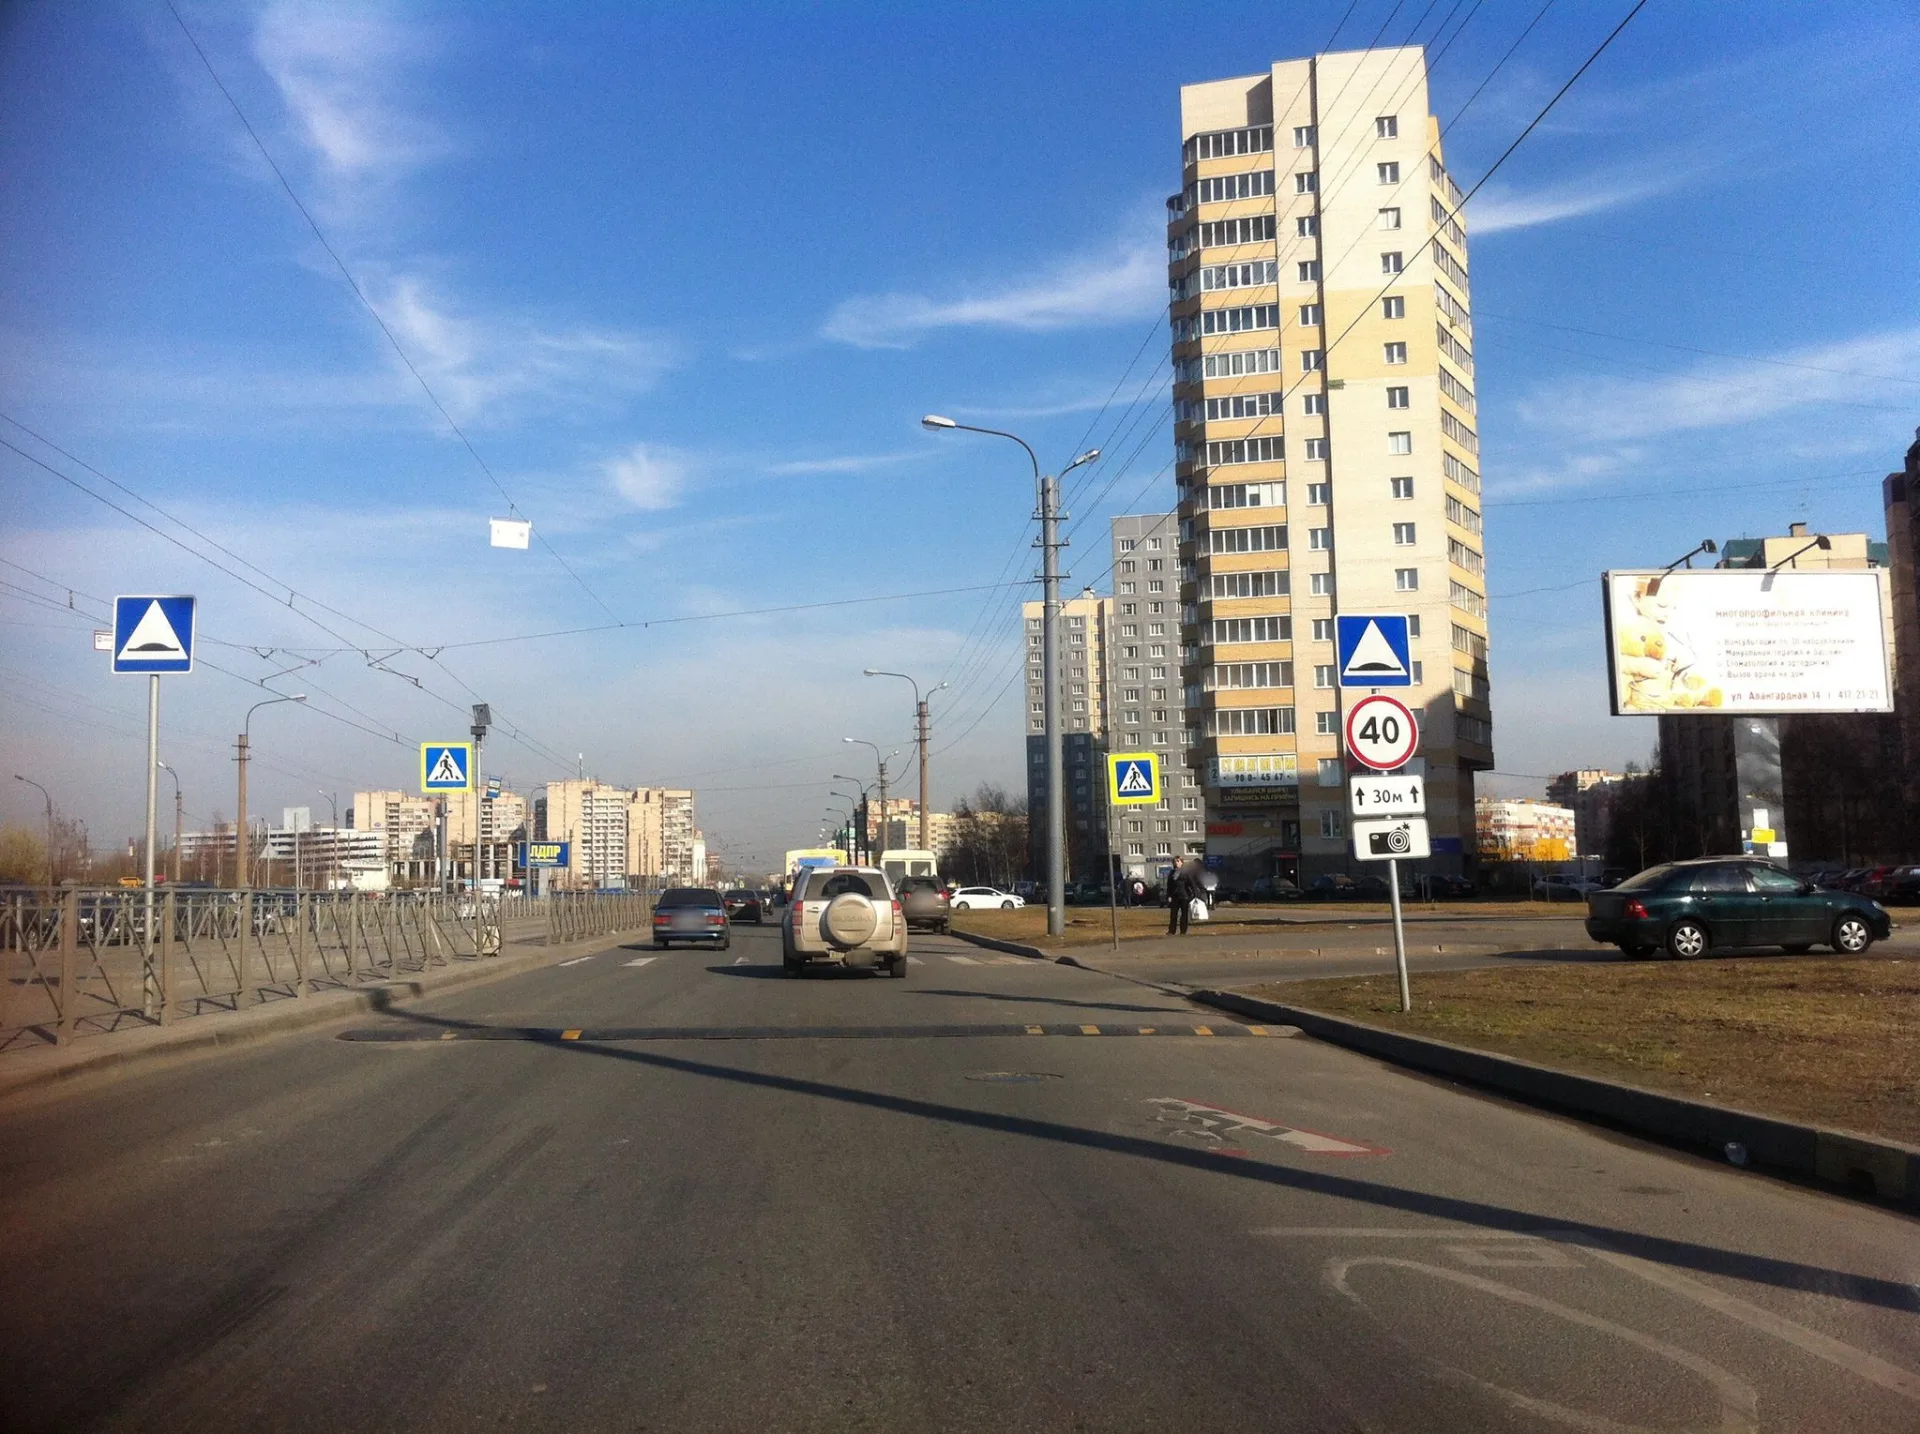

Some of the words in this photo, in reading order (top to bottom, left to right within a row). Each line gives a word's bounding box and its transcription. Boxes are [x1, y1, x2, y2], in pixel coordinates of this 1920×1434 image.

[1748, 691, 1808, 702] Авангардная
[1359, 716, 1399, 744] 40
[1373, 789, 1403, 804] 30м
